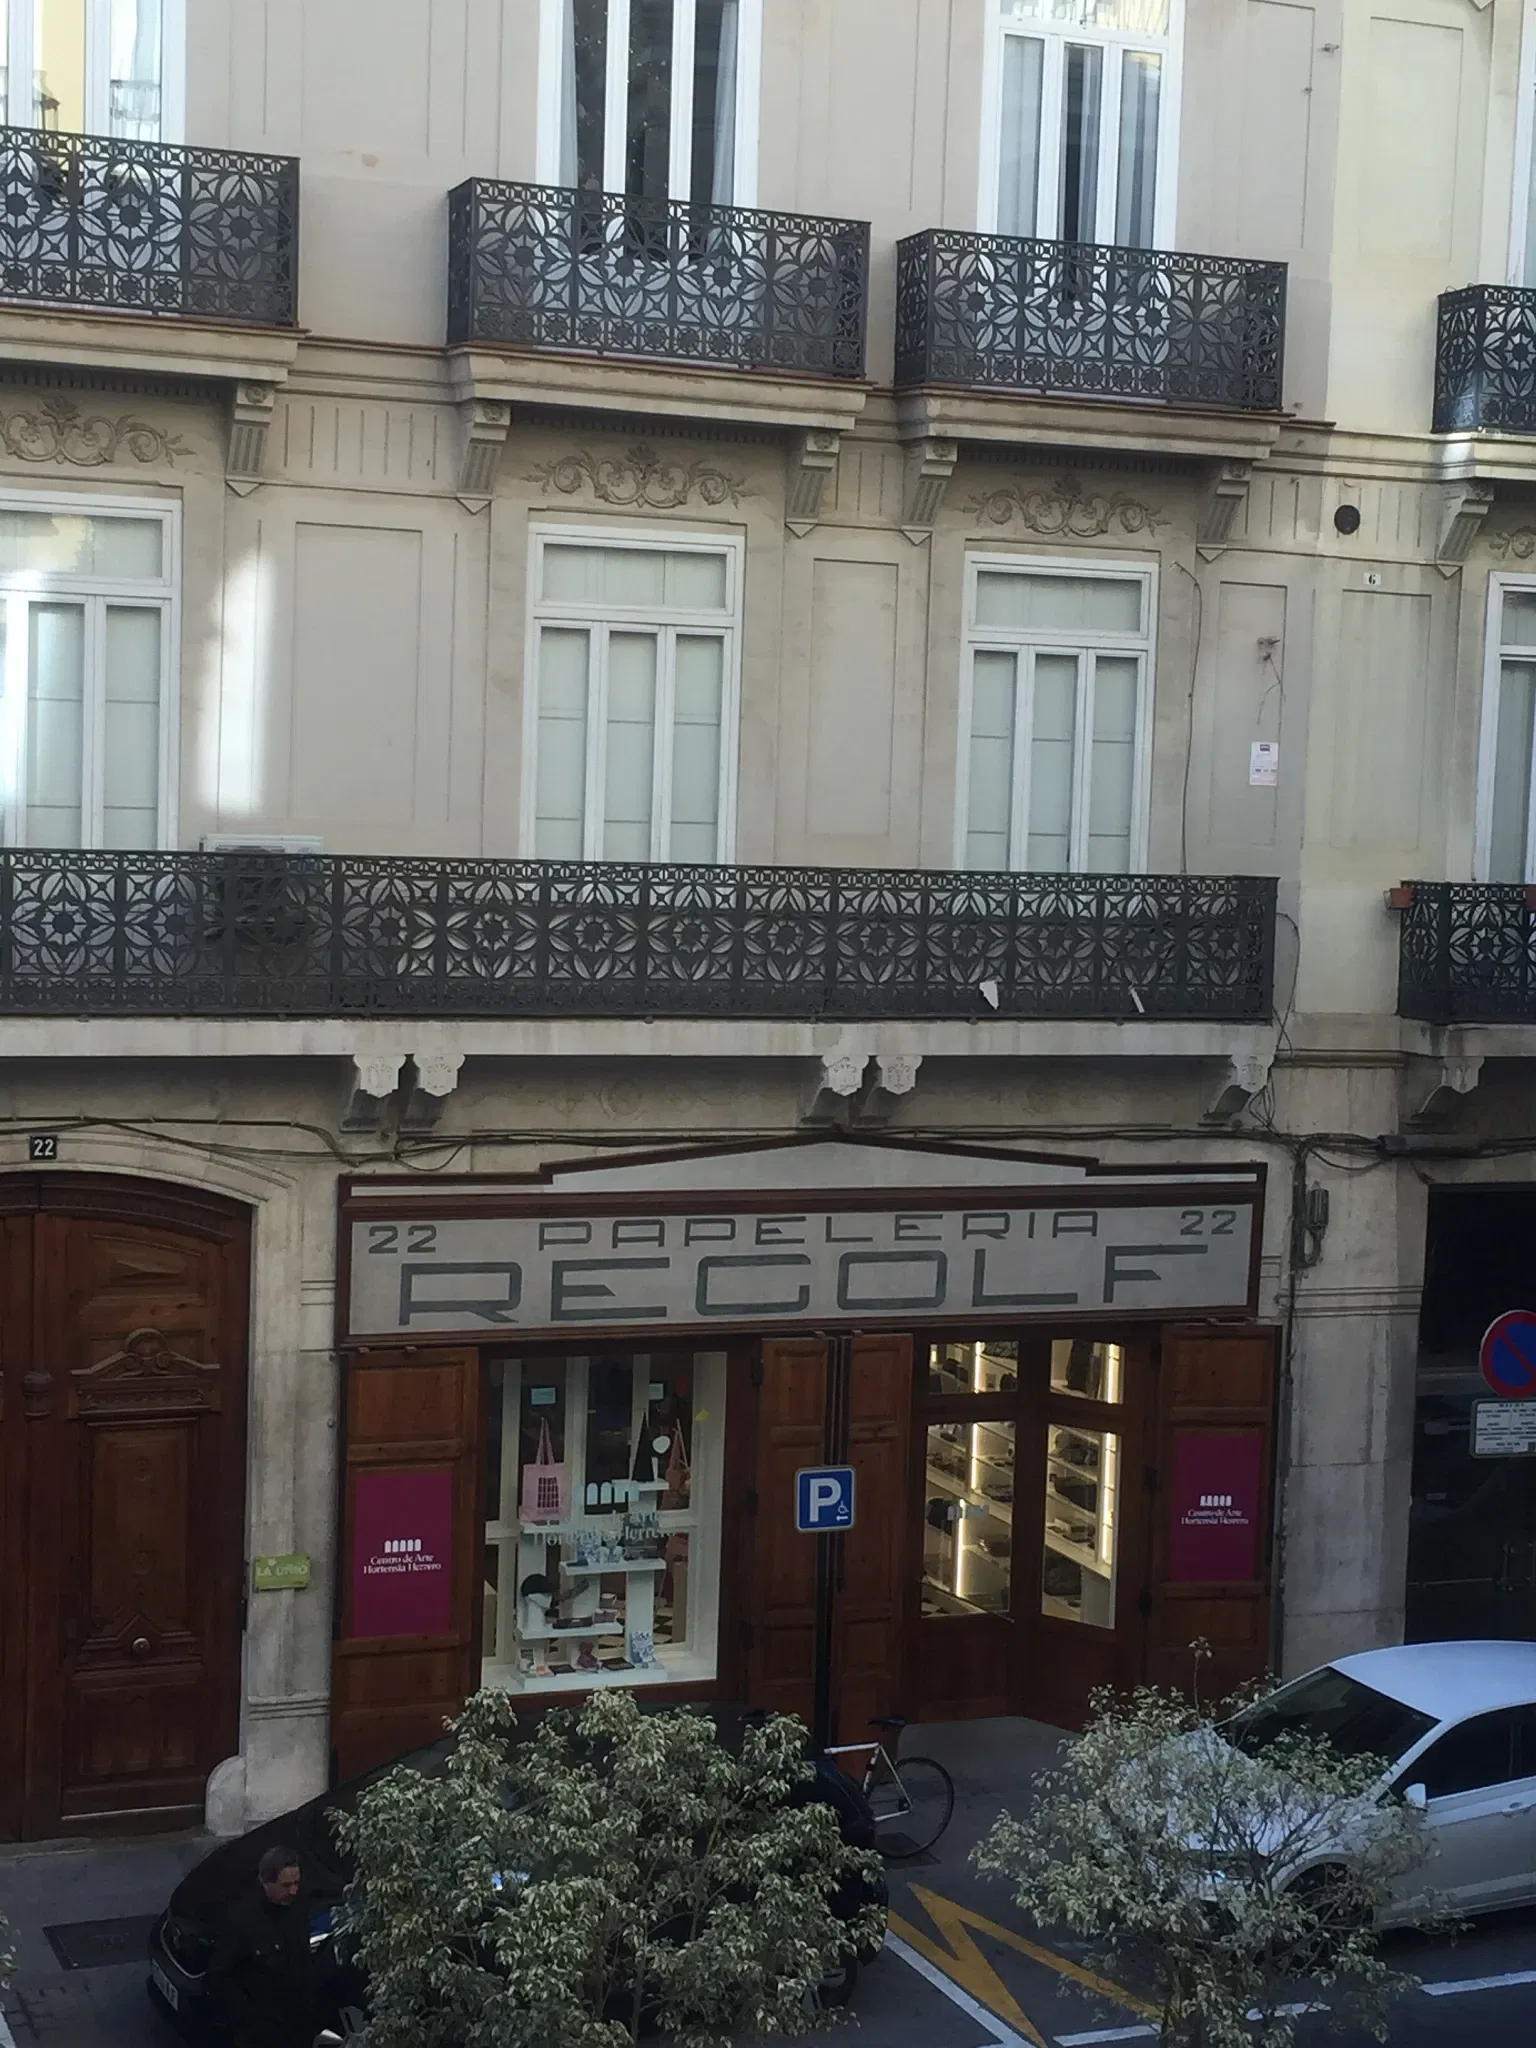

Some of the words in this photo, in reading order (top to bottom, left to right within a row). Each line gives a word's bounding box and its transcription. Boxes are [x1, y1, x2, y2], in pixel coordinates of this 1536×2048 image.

[34, 1139, 55, 1156] 22
[368, 1224, 437, 1254] 22
[538, 1211, 1098, 1251] PAPELERIA
[1180, 1209, 1237, 1236] 22
[809, 1478, 842, 1522] P
[370, 1555, 401, 1565] Centro
[402, 1553, 413, 1563] de
[415, 1553, 434, 1563] Arte
[363, 1563, 406, 1575] Hortensia
